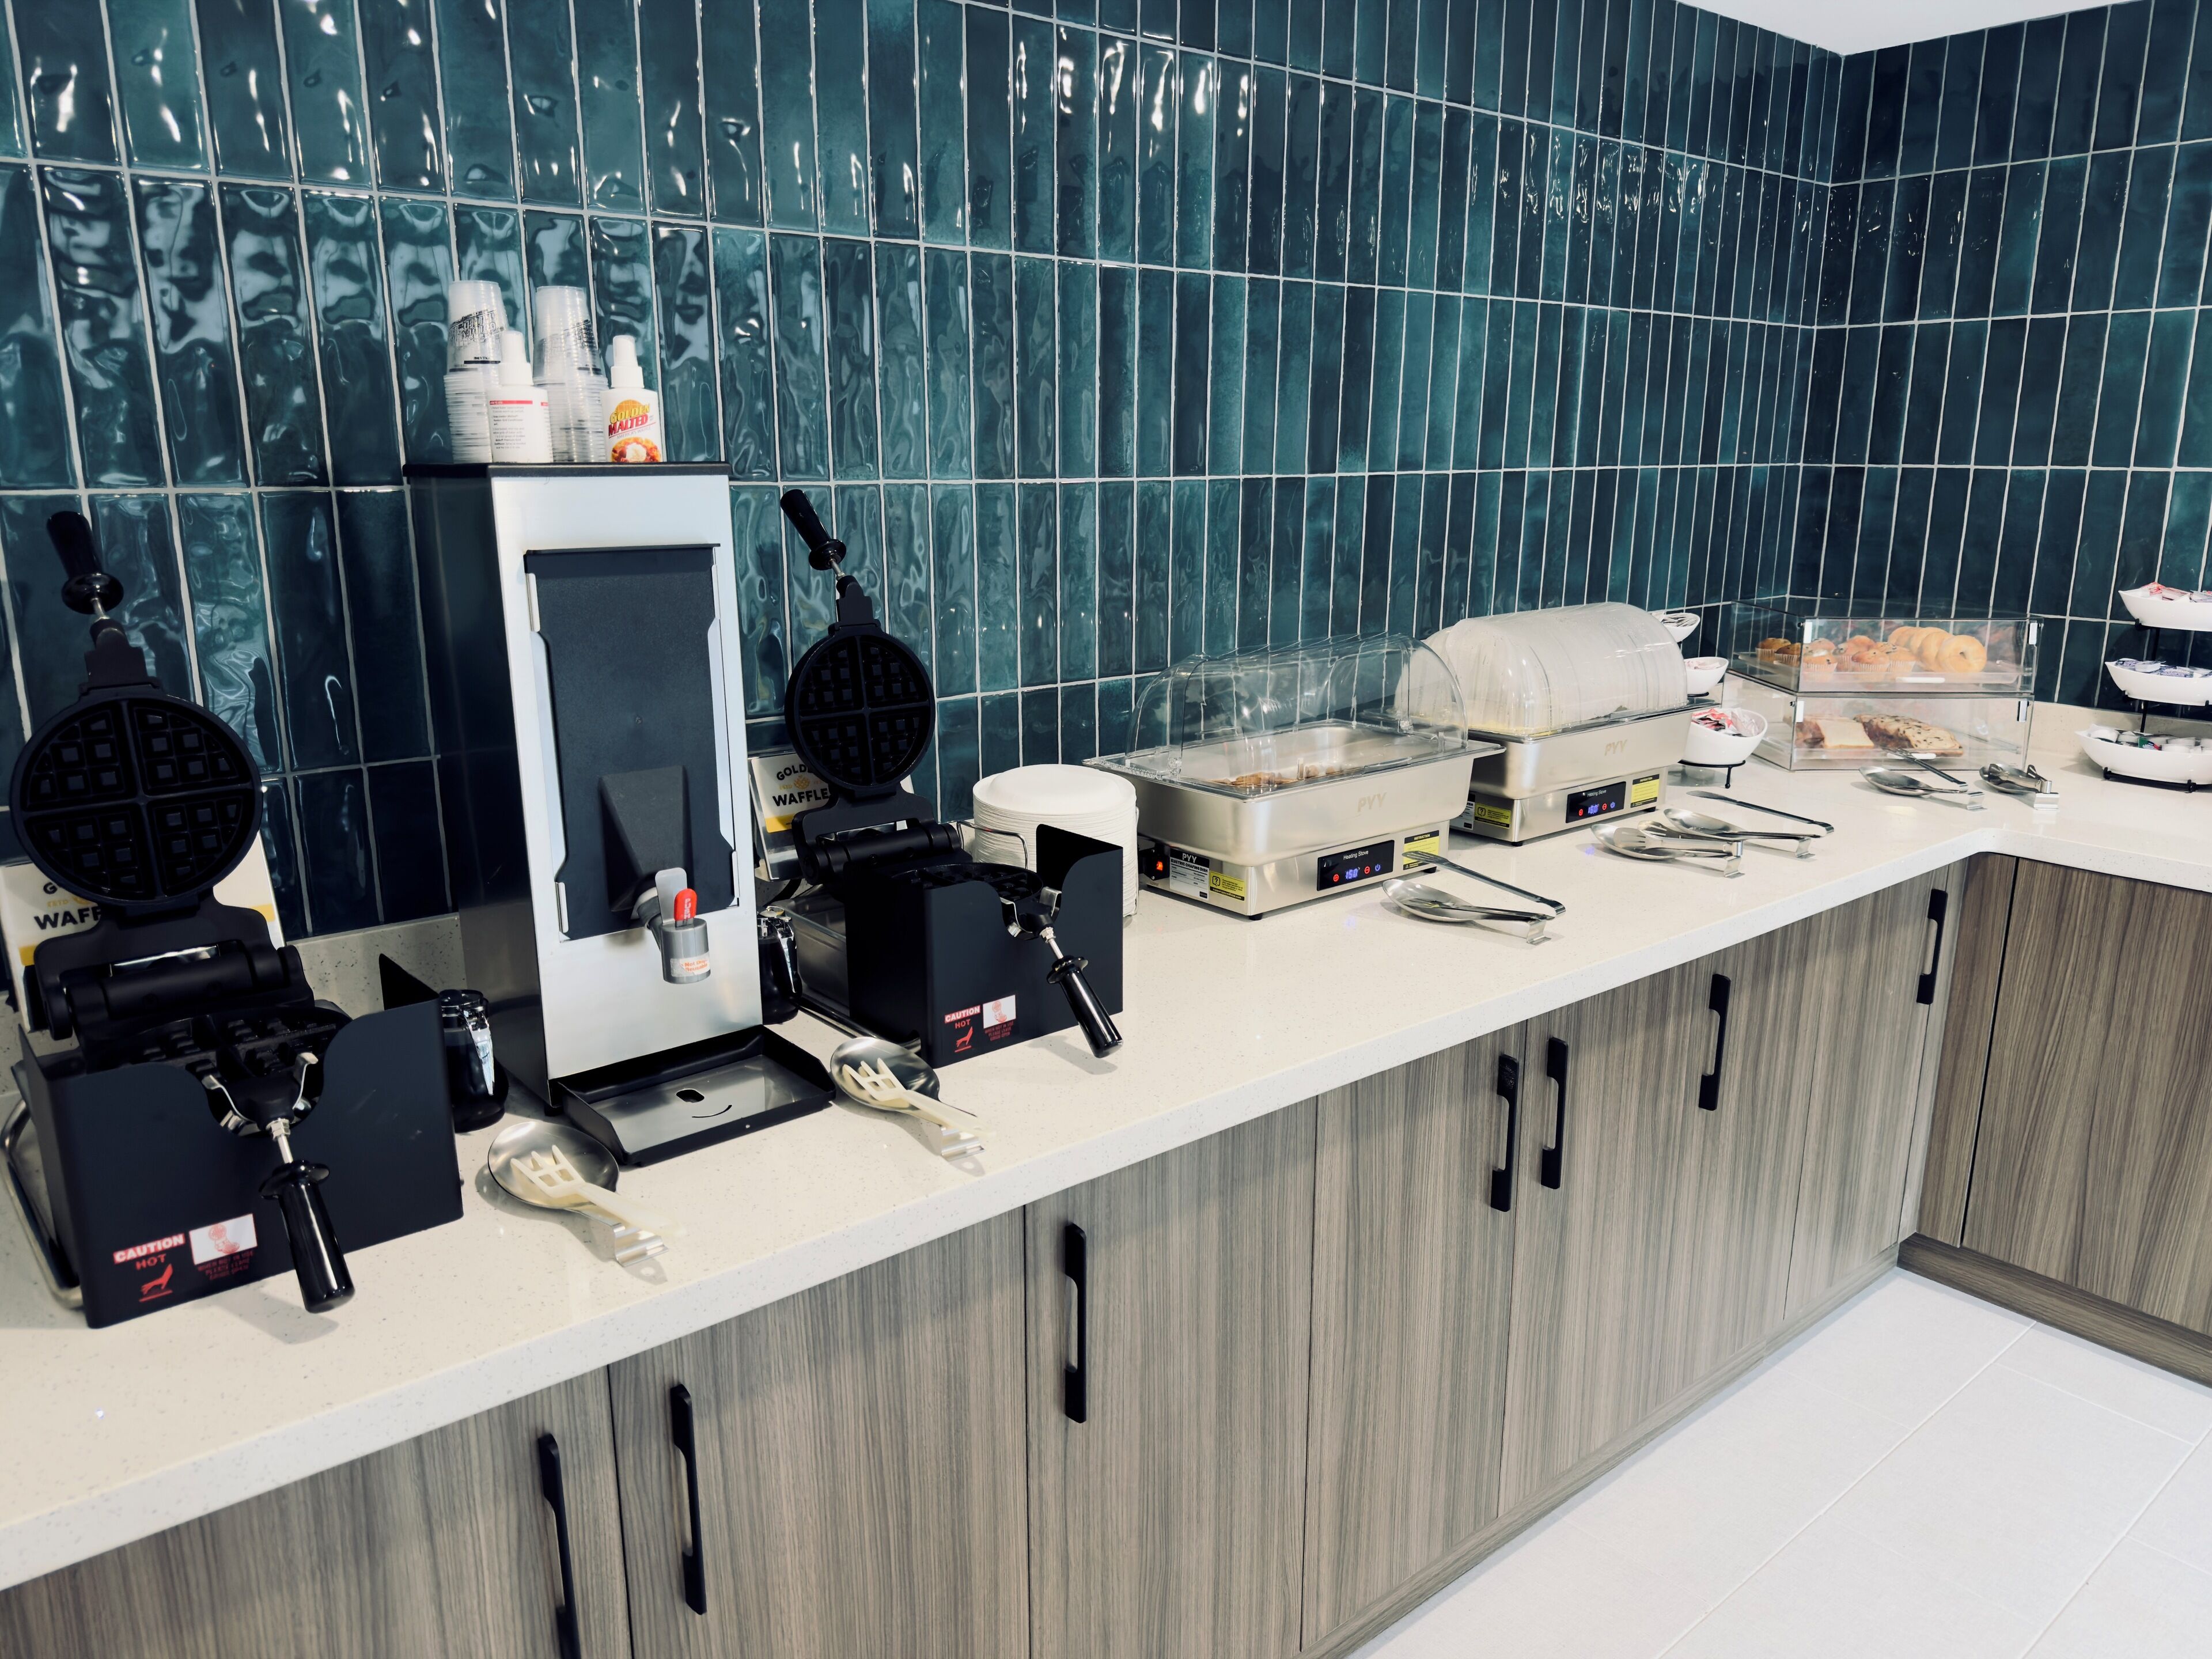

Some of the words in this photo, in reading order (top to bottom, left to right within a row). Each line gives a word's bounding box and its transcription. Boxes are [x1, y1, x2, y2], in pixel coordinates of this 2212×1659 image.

[610, 404, 650, 424] GOLDEN
[608, 414, 648, 437] MALTED
[1604, 739, 1627, 756] PYY
[777, 764, 808, 781] GOLD
[772, 788, 829, 806] WAFFLE
[1357, 793, 1387, 812] PYY
[1171, 858, 1185, 866] ELECTRIC
[1185, 862, 1200, 871] CHAFING
[1182, 853, 1197, 863] PYY
[1345, 868, 1358, 880] 150
[945, 1006, 980, 1022] CAUTION
[955, 1018, 971, 1029] HOT
[116, 1233, 184, 1262] CAUTION
[136, 1253, 166, 1270] HOT
